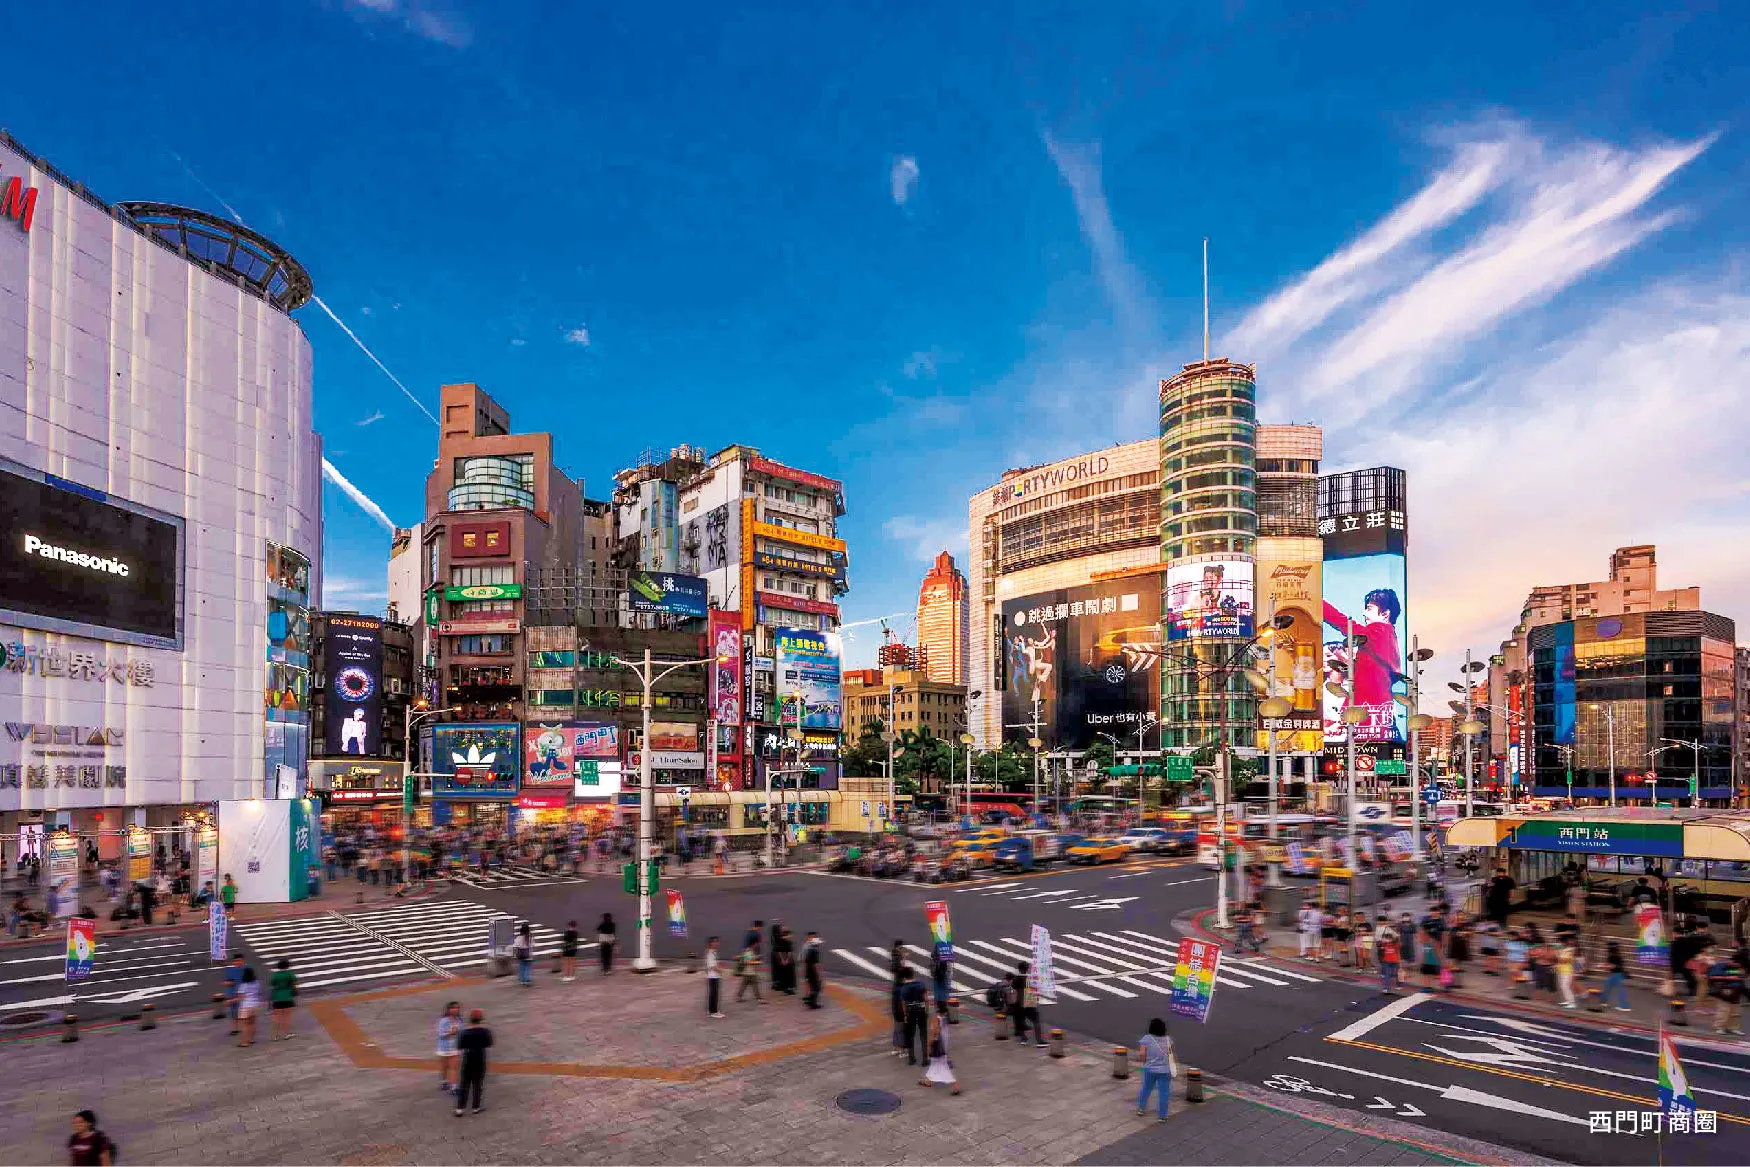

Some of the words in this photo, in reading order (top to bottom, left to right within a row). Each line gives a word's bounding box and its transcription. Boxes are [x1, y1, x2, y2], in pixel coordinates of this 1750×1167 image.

[1008, 456, 1109, 502] PRTYWORLD
[1318, 512, 1386, 536] 德立莊
[25, 534, 129, 576] Panasonic
[1028, 596, 1117, 624] 跳過攔車鬧劇
[7, 639, 154, 688] 新世界大樓
[1087, 713, 1114, 724] Uber
[1324, 746, 1378, 754] MIDOWN
[1558, 826, 1609, 840] 西門站
